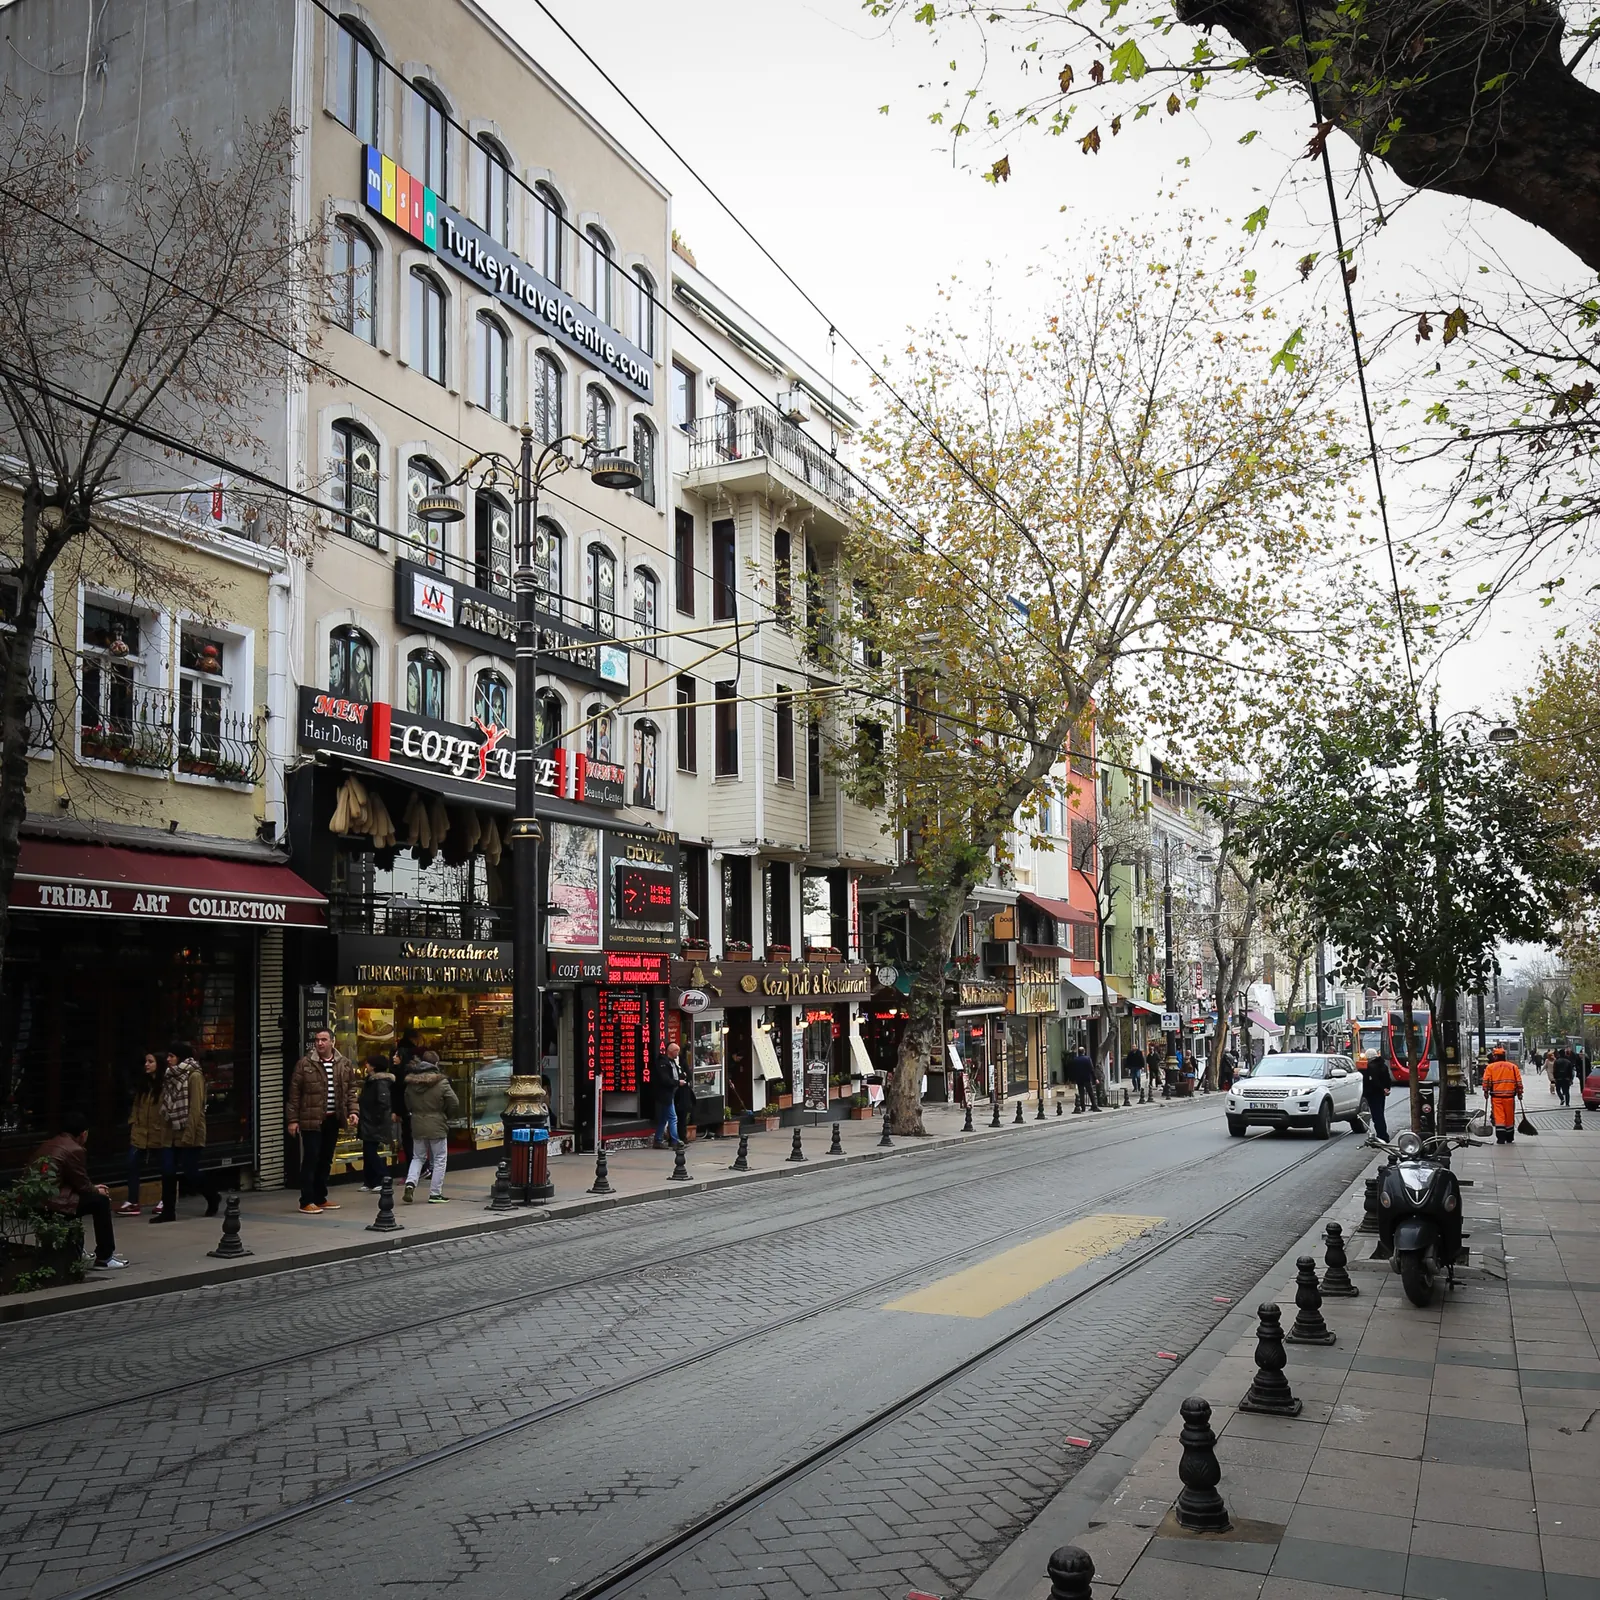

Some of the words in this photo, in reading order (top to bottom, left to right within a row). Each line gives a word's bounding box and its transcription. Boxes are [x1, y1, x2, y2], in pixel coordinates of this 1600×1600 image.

[444, 216, 651, 390] TurkeyTravelCentre.com
[312, 694, 368, 724] MEN
[304, 719, 331, 741] Hair
[332, 724, 368, 752] Design
[132, 893, 170, 913] ART
[188, 897, 287, 921] COLLECTION
[401, 940, 499, 960] Sultanahmet
[763, 973, 789, 1002] Cozy
[792, 973, 811, 996] Pub
[813, 974, 820, 994] &
[822, 973, 868, 995] Restaurant
[587, 1009, 595, 1080] CHANGE
